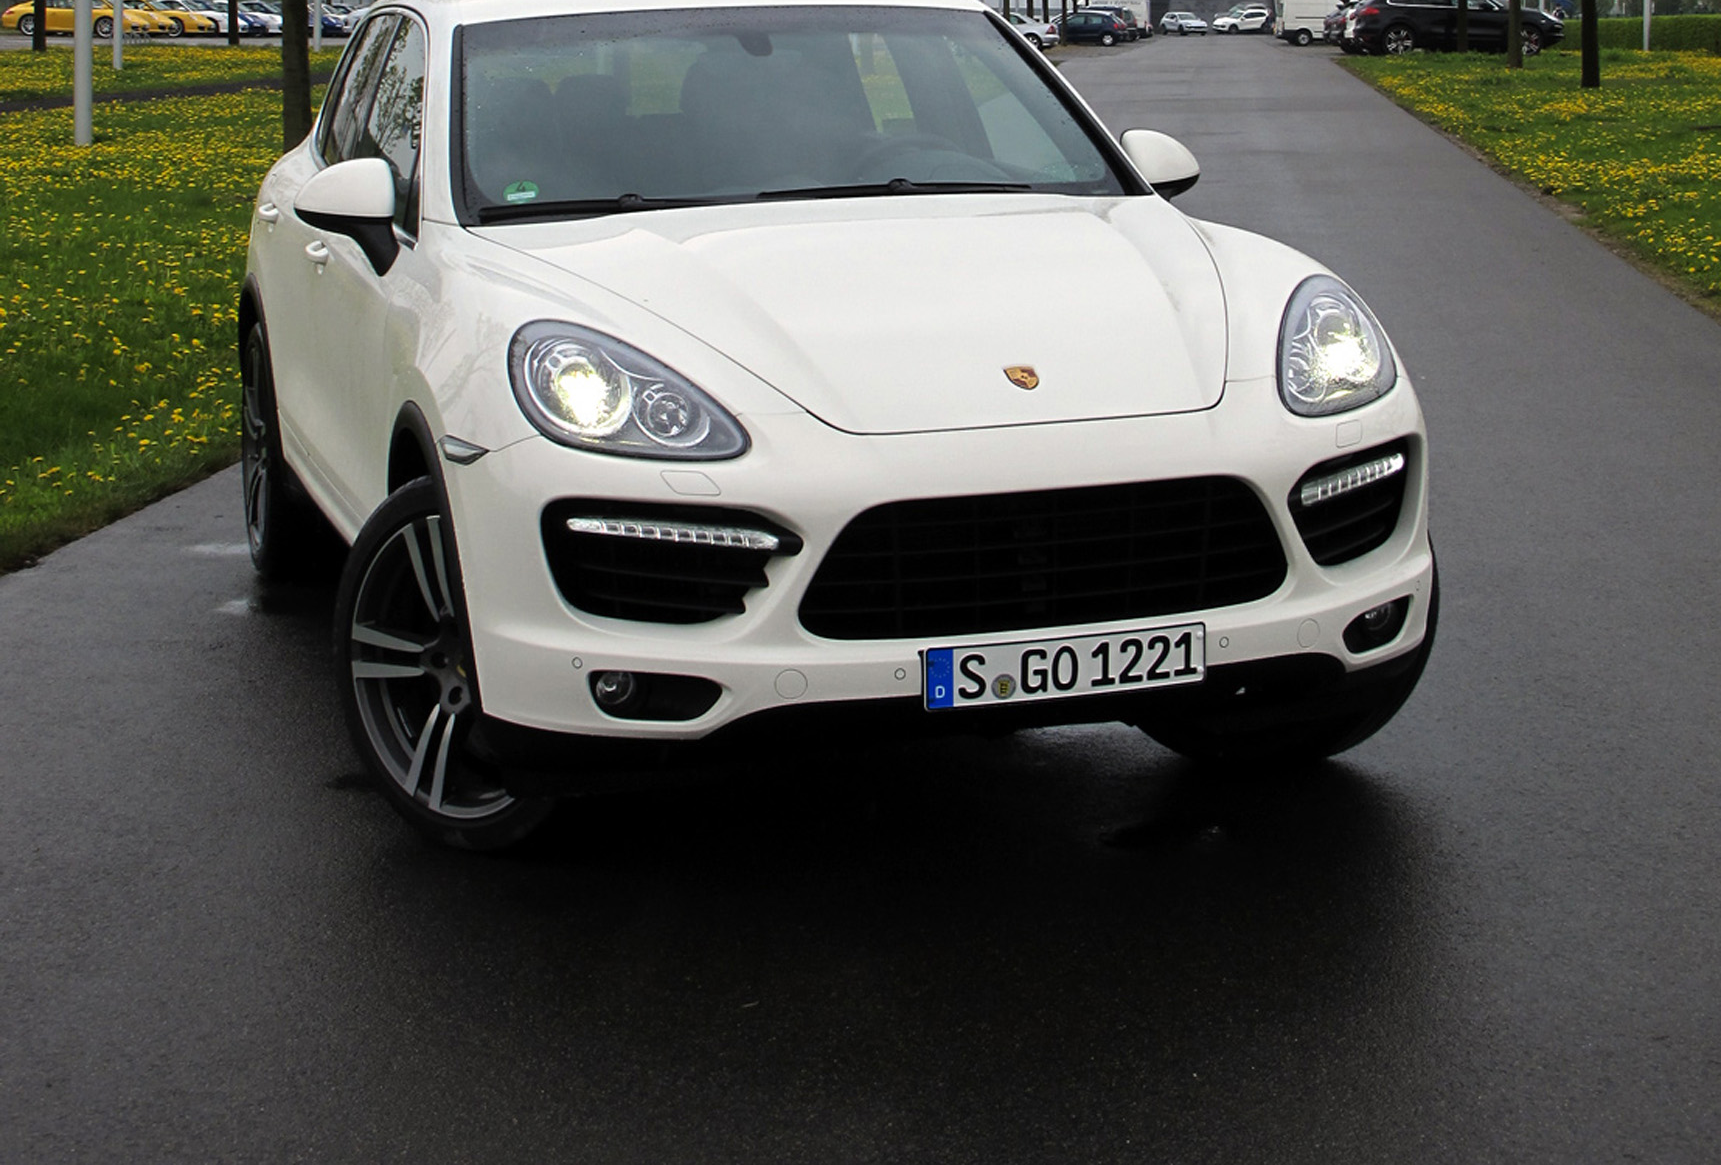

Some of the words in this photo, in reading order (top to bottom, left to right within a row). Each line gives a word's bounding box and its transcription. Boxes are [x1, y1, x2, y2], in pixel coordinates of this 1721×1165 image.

[957, 653, 987, 700] S
[1020, 645, 1079, 694] GO
[1091, 631, 1198, 687] 1221
[935, 686, 945, 698] D
